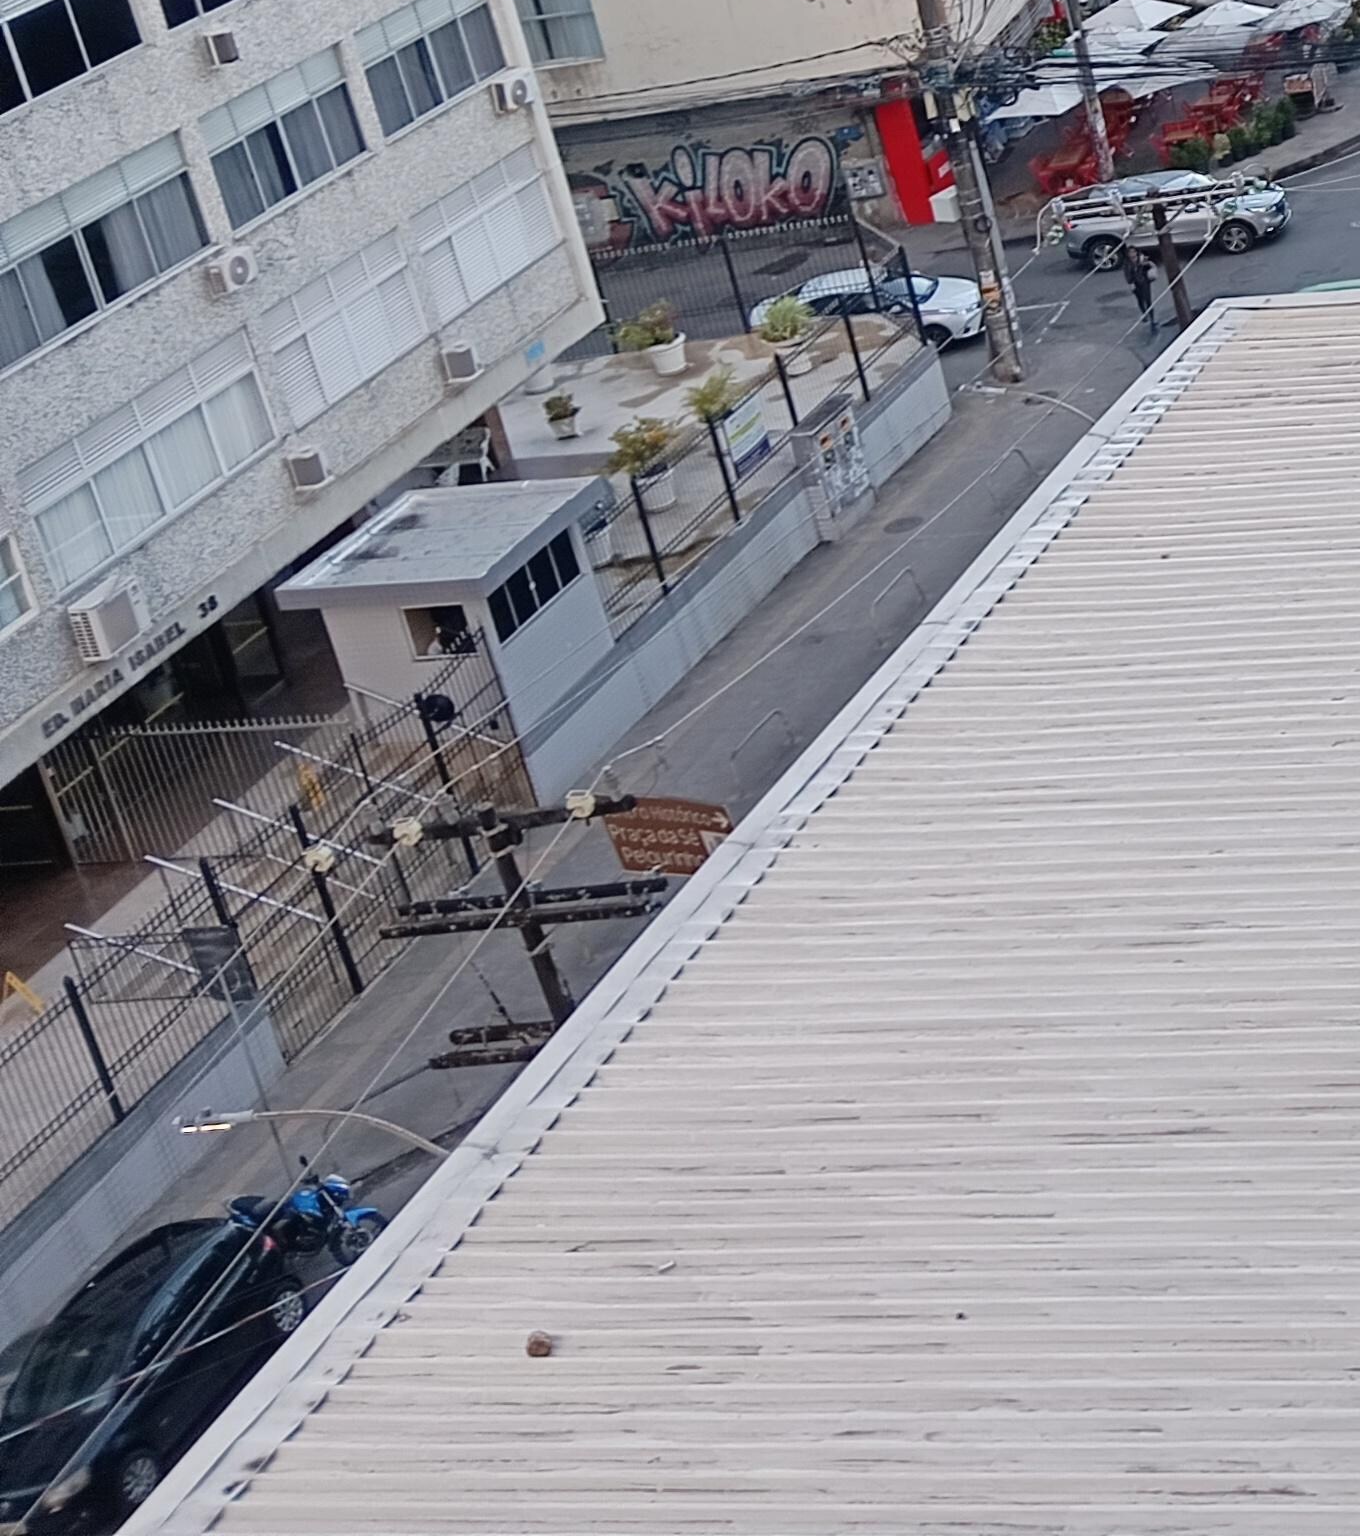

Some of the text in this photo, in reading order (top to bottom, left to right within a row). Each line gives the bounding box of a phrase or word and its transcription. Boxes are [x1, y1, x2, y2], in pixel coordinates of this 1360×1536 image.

[70, 668, 124, 714] MARIA
[128, 622, 186, 671] ISABEL
[608, 824, 656, 847] Praça
[657, 829, 679, 845] da
